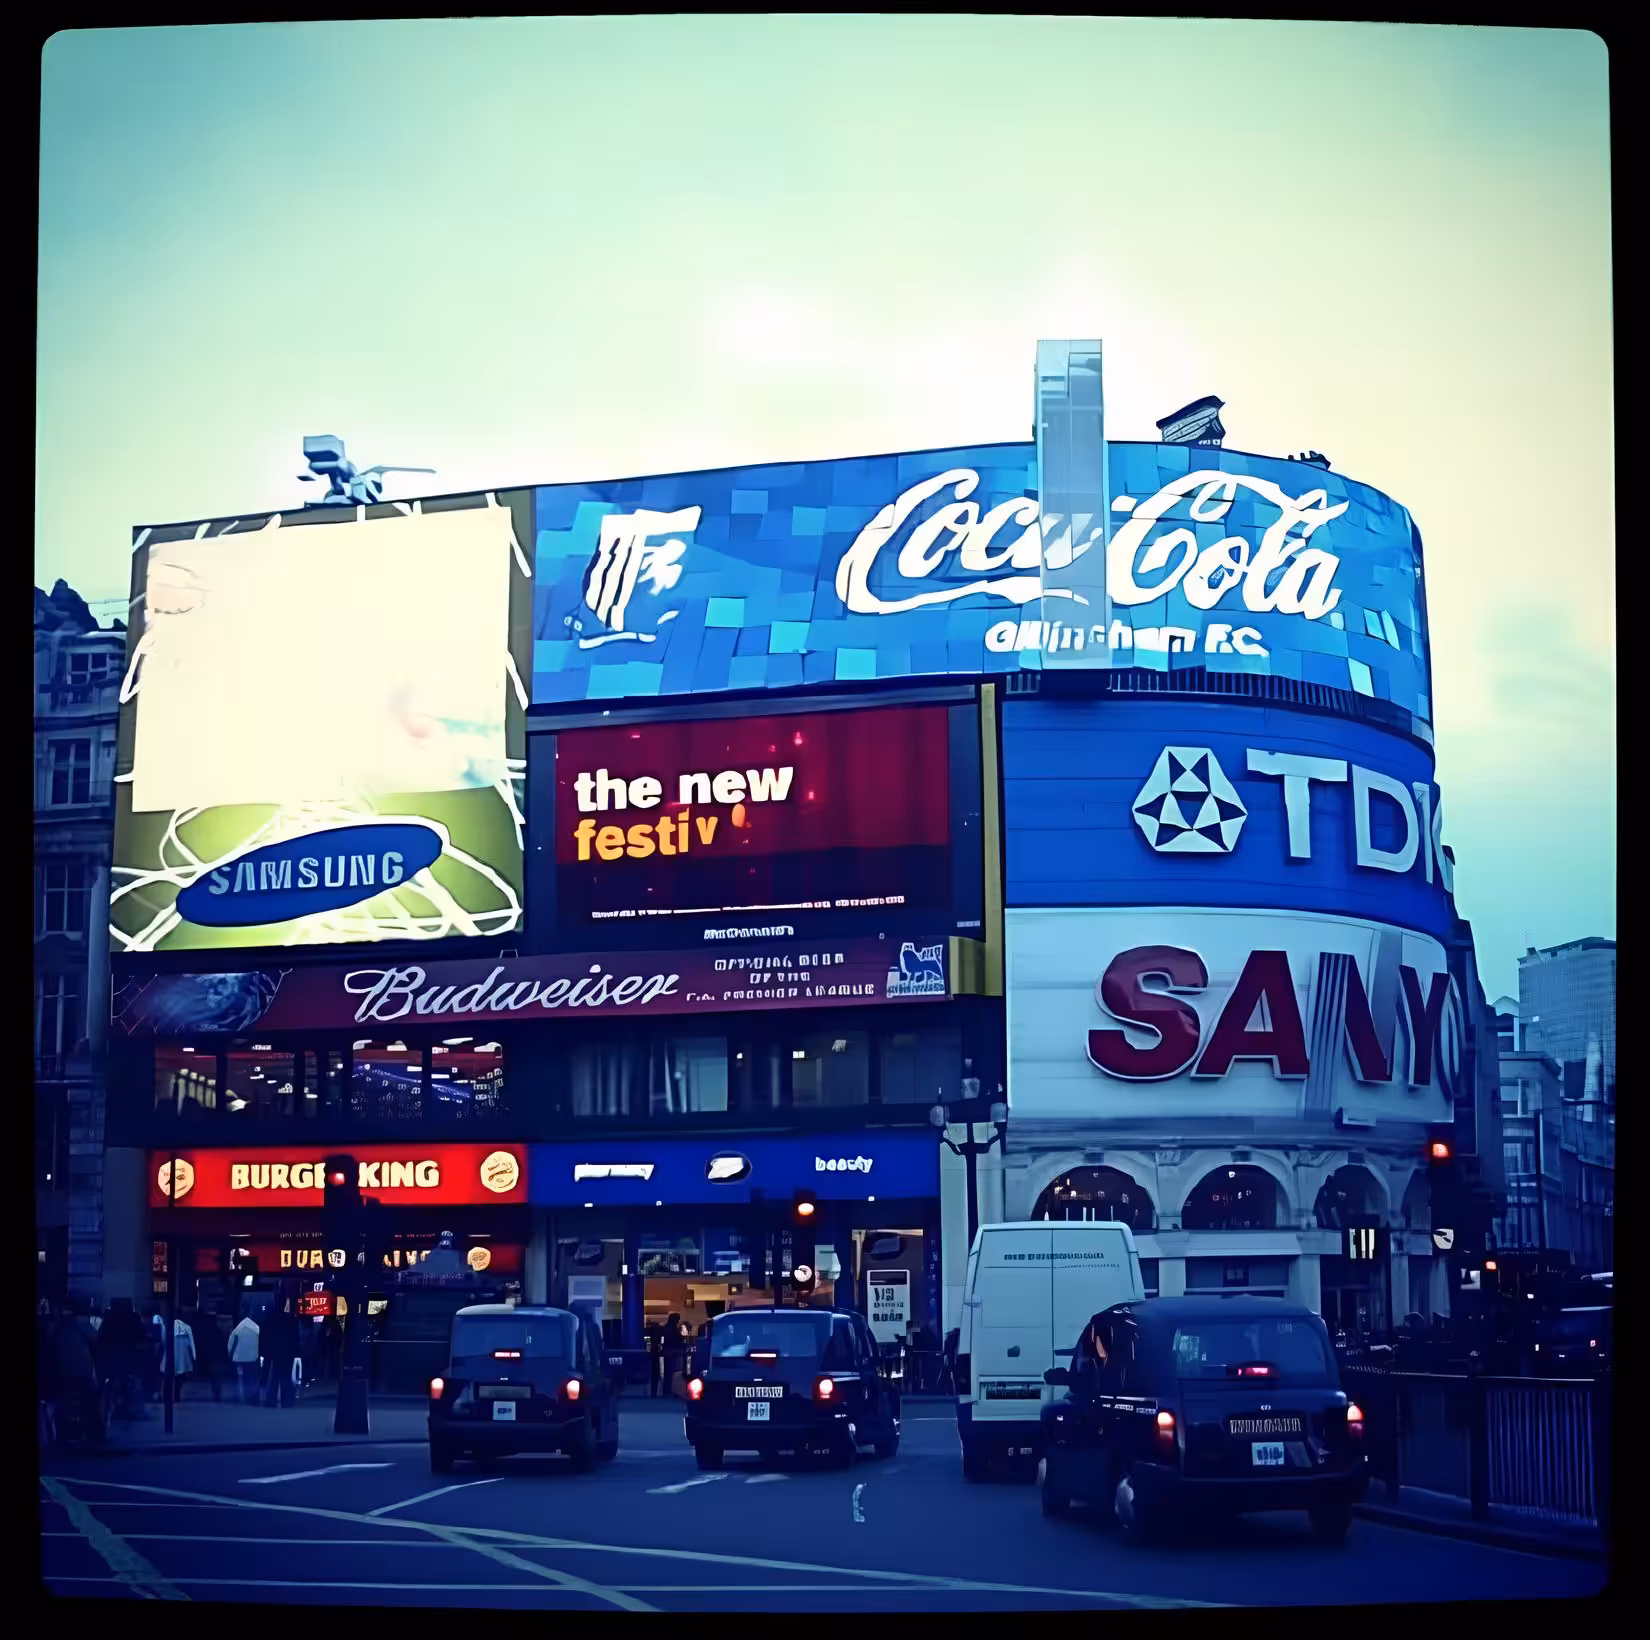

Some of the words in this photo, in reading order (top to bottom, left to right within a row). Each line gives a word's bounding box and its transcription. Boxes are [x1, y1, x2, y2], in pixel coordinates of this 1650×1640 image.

[573, 768, 662, 812] the
[679, 766, 794, 804] new
[1246, 748, 1454, 894] TDK
[208, 851, 405, 895] SAMSUNG
[344, 964, 679, 1023] Budweiser
[231, 1162, 326, 1190] BURGE
[358, 1160, 440, 1189] KING
